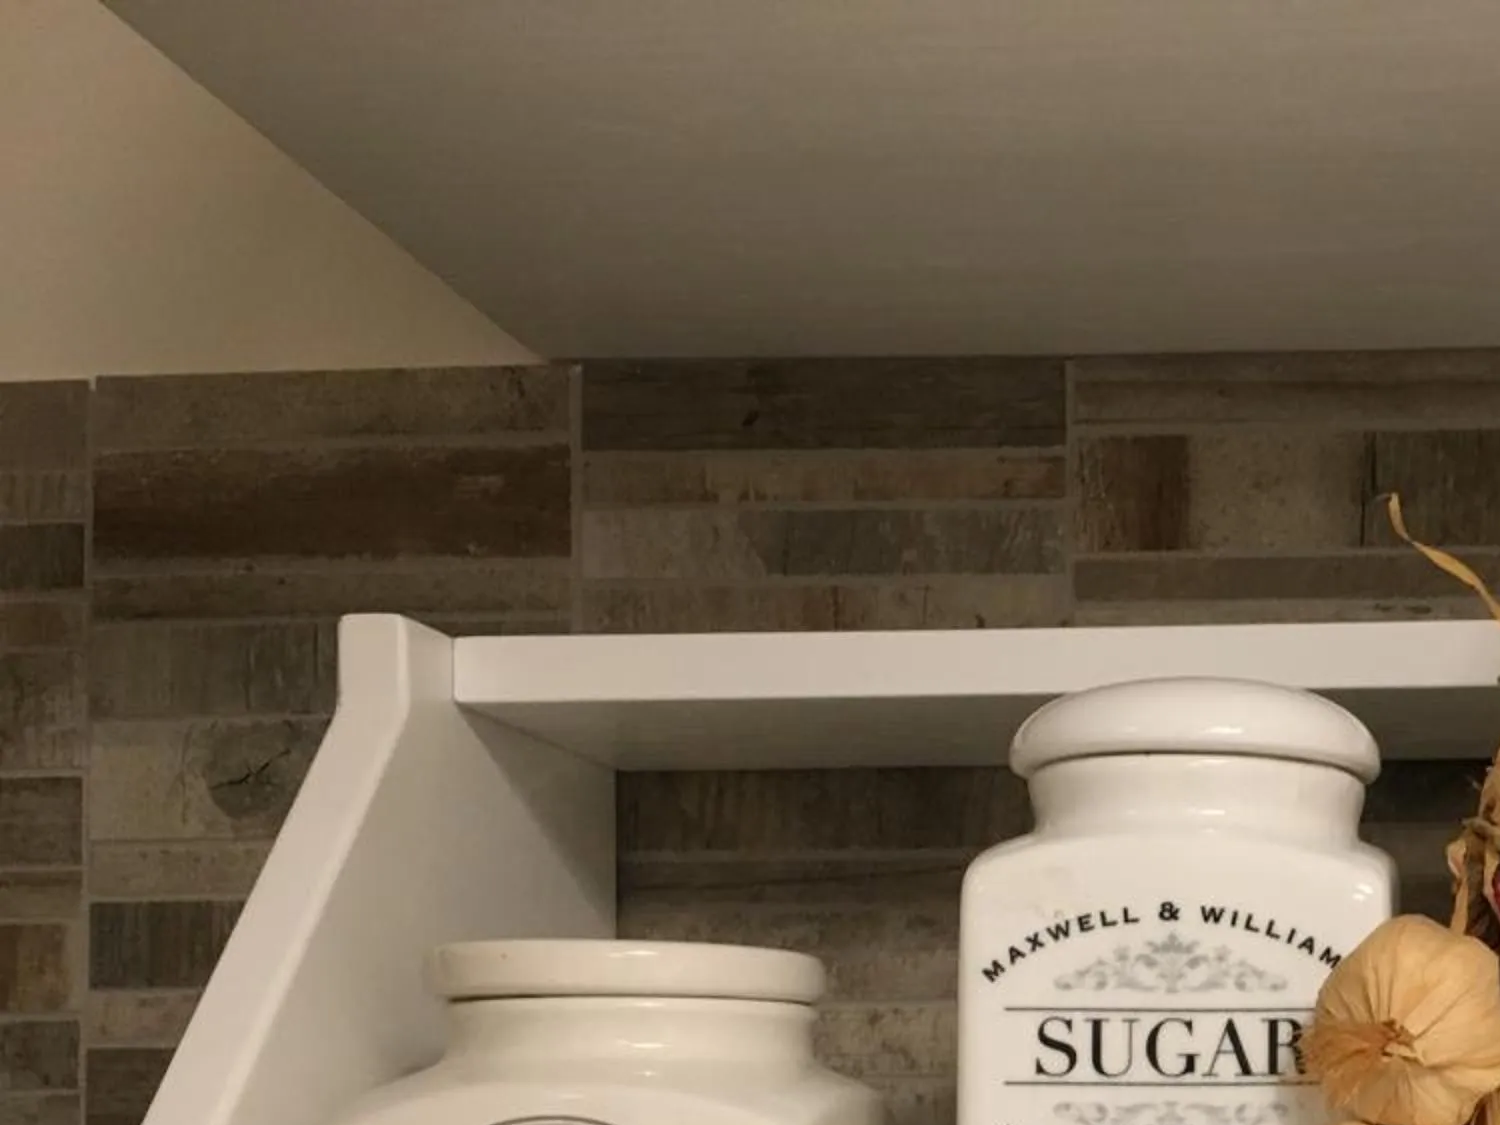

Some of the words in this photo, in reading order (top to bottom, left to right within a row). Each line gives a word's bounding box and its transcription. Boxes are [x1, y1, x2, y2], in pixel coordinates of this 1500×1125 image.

[982, 907, 1140, 982] MAXWELL
[1158, 901, 1180, 922] &
[1035, 1016, 1306, 1078] SUGAR
